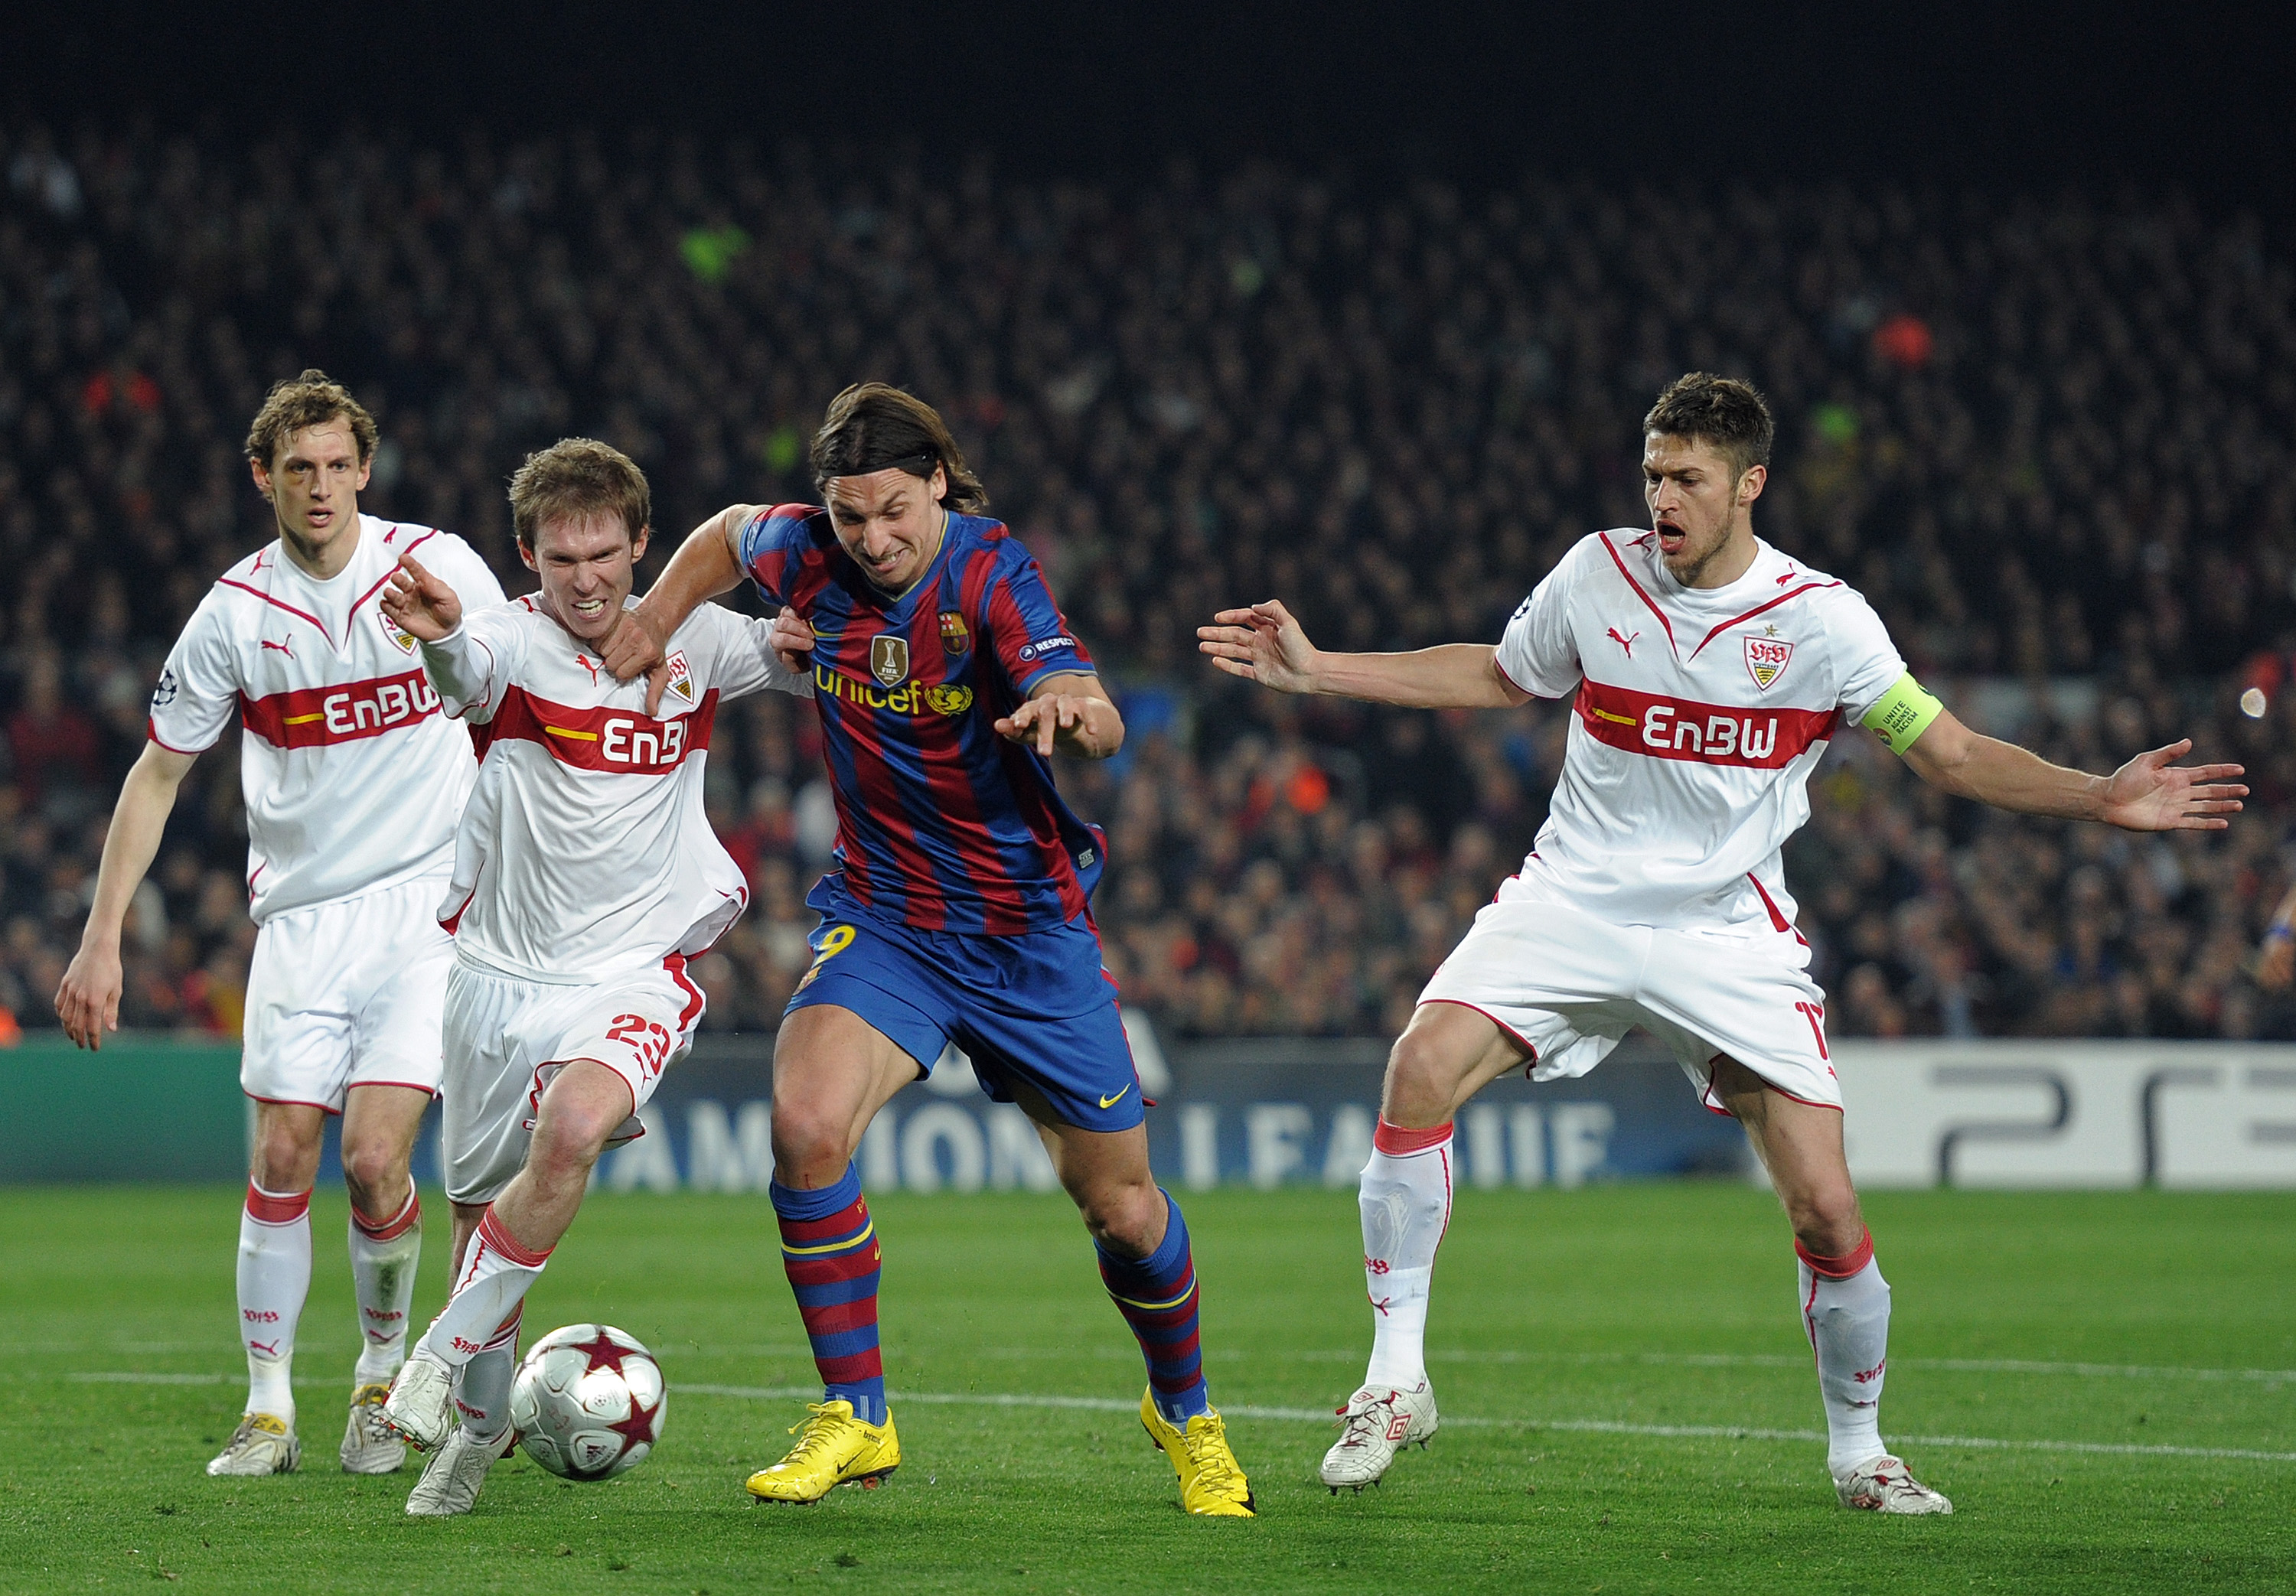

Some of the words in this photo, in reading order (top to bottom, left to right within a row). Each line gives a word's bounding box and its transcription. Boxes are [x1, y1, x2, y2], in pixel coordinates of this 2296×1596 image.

[1035, 637, 1075, 652] RESPECT
[816, 664, 921, 715] unicef
[882, 666, 898, 675] FIFA
[324, 679, 441, 734] EnBW
[1883, 700, 1906, 725] UNITE
[1891, 706, 1913, 729] AGAINST
[1896, 711, 1919, 734] RACISM
[602, 718, 688, 765] EnB
[1642, 705, 1778, 759] EnBW
[815, 925, 856, 965] 9
[605, 1014, 670, 1076] 23
